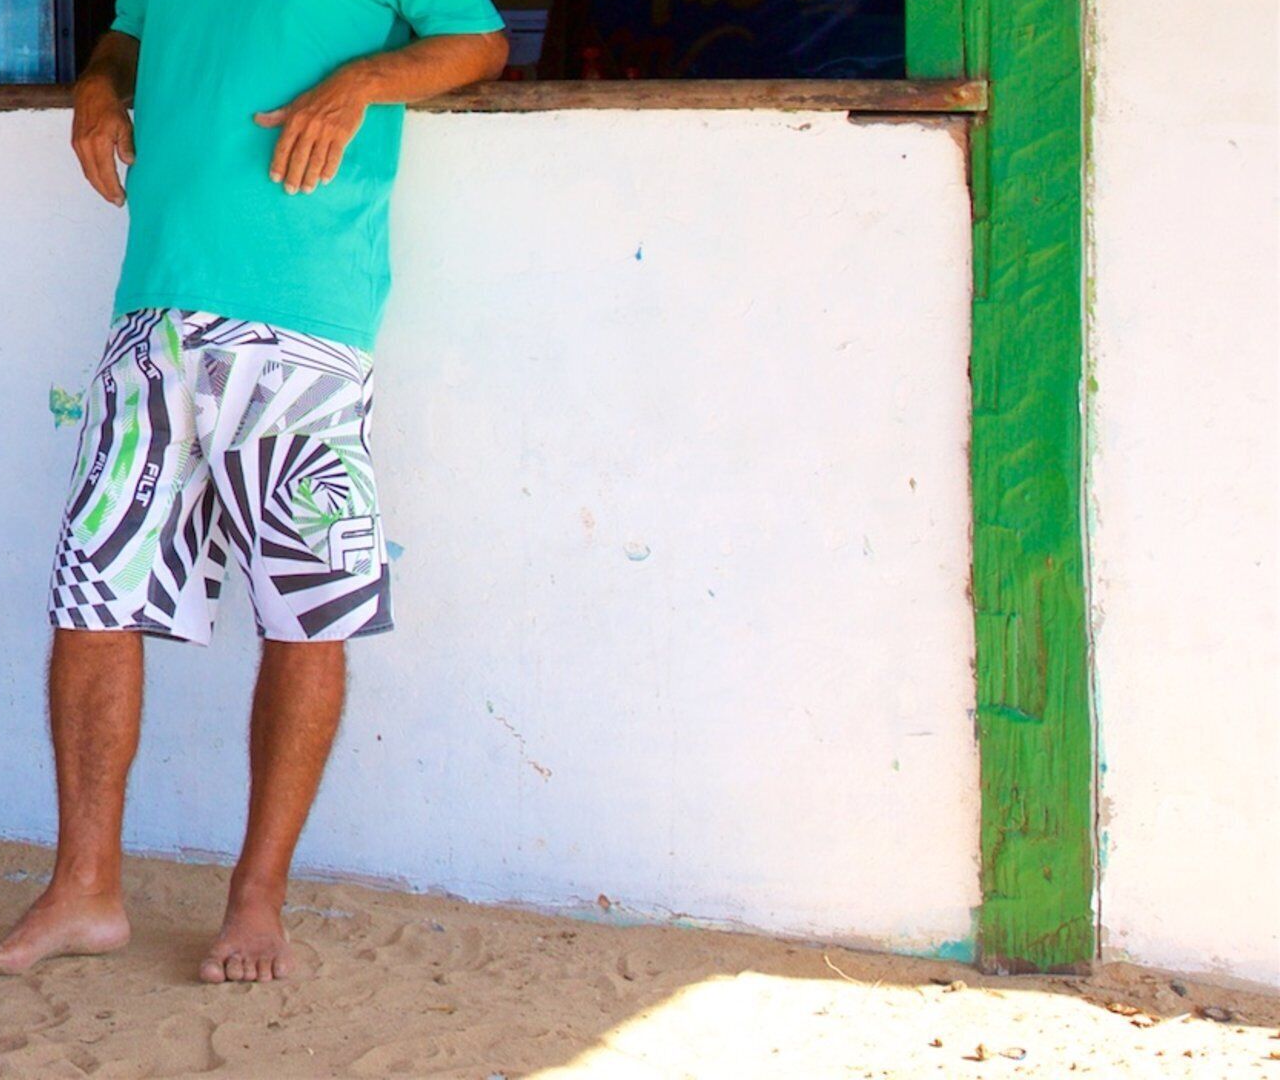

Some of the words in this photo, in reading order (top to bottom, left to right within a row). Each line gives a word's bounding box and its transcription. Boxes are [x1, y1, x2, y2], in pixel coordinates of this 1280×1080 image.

[136, 341, 161, 381] FILT
[88, 451, 108, 486] FILT
[135, 461, 160, 508] FILT
